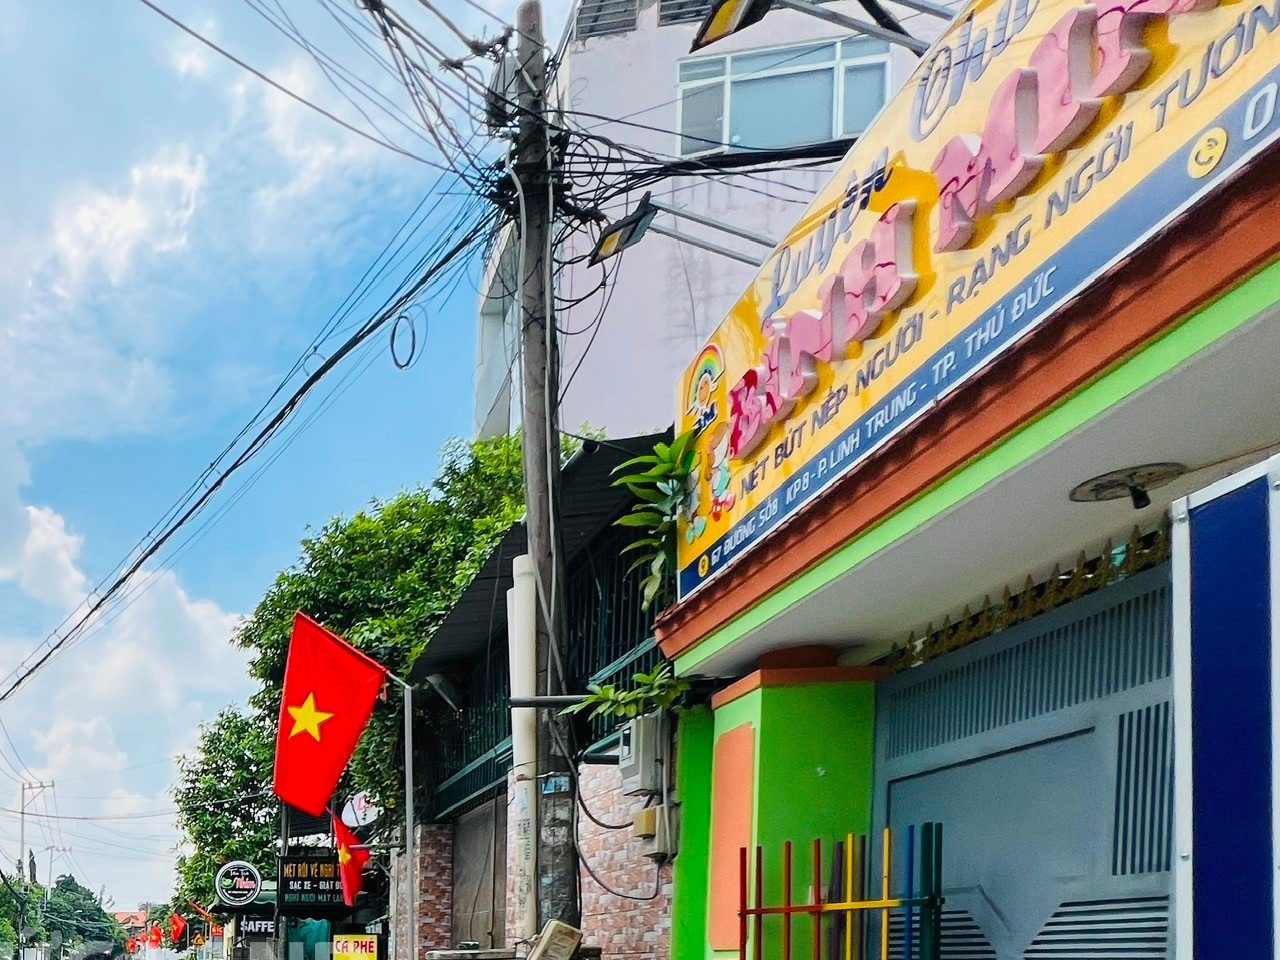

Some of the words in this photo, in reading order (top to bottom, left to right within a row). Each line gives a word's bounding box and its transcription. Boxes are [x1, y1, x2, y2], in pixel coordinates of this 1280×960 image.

[741, 455, 770, 500] NÉT
[774, 420, 807, 466] BÚT
[811, 384, 848, 436] NẾP
[854, 311, 924, 396] NGƯỜI
[946, 213, 1032, 316] RẠNG
[866, 381, 917, 438] TRUNG
[932, 350, 958, 385] TP.
[965, 305, 1007, 359] THỦ
[1011, 265, 1057, 323] ĐỨC
[303, 881, 311, 890] XE
